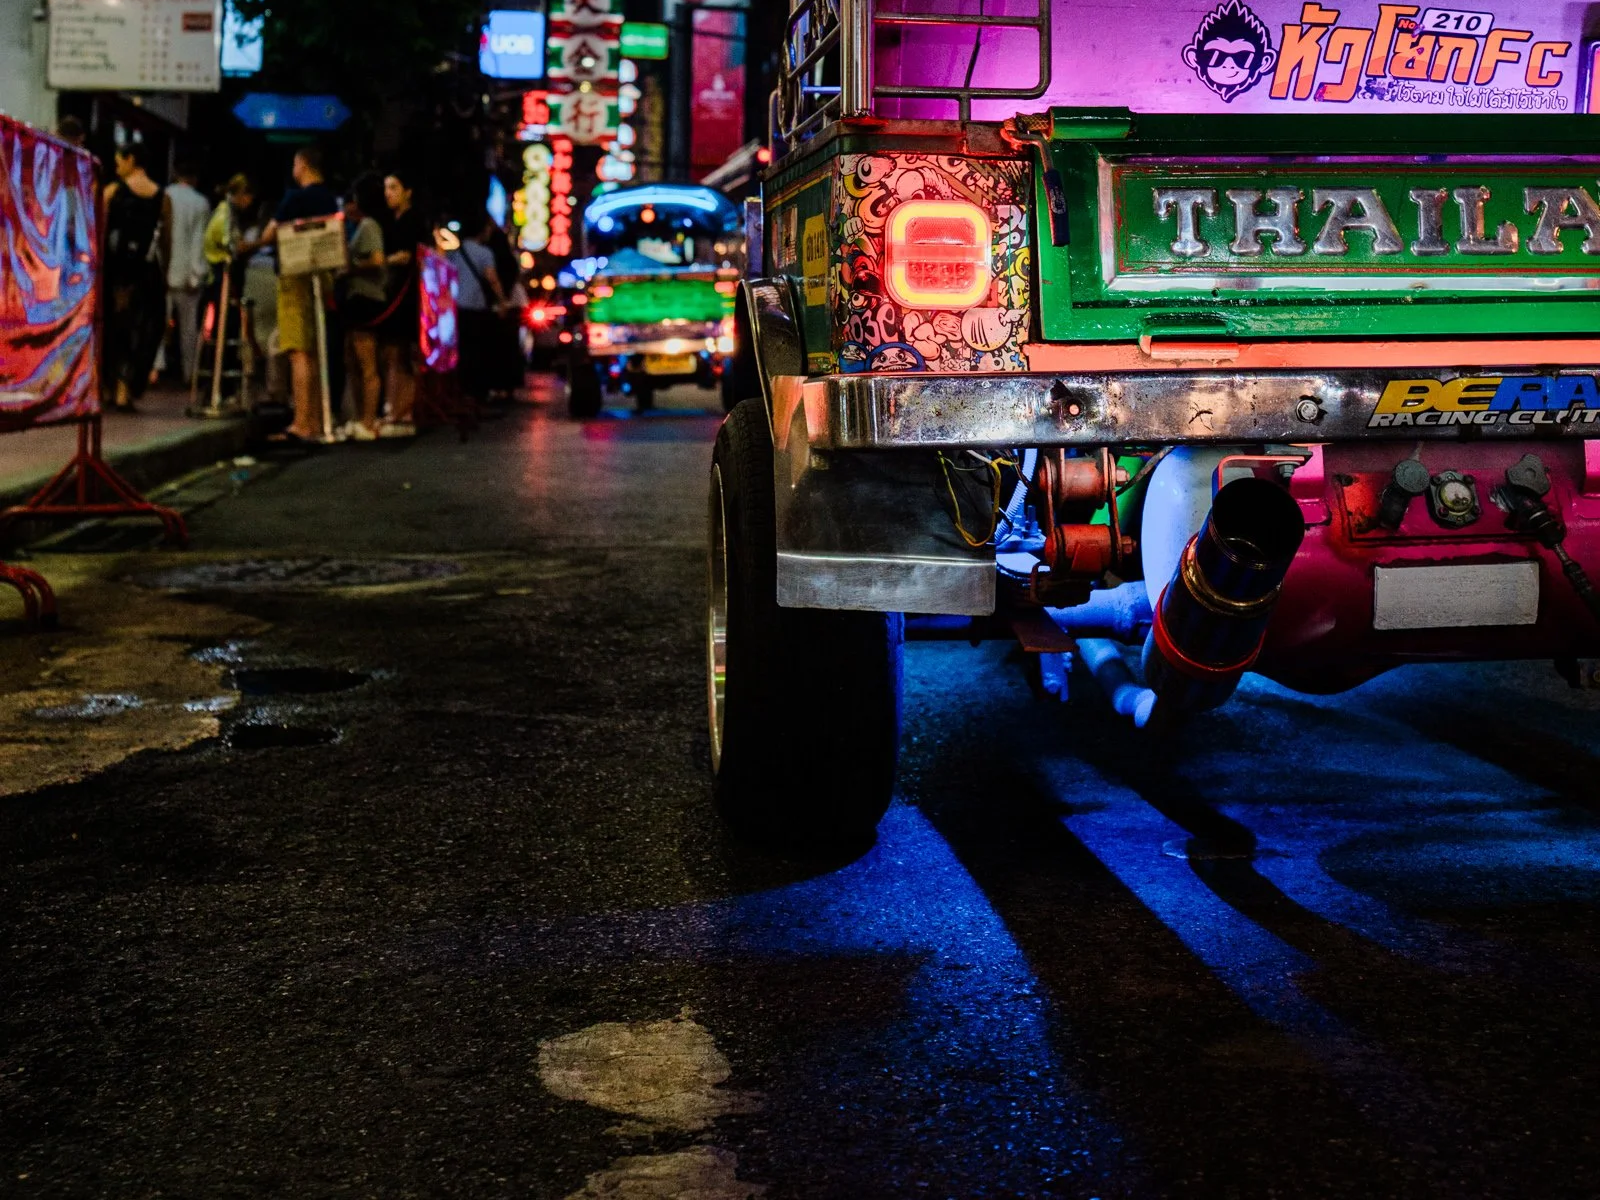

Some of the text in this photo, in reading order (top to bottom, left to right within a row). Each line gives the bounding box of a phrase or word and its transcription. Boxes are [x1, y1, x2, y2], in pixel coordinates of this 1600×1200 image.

[1432, 12, 1482, 32] 210
[1153, 185, 1600, 257] THAILA
[1368, 411, 1499, 427] RACING
